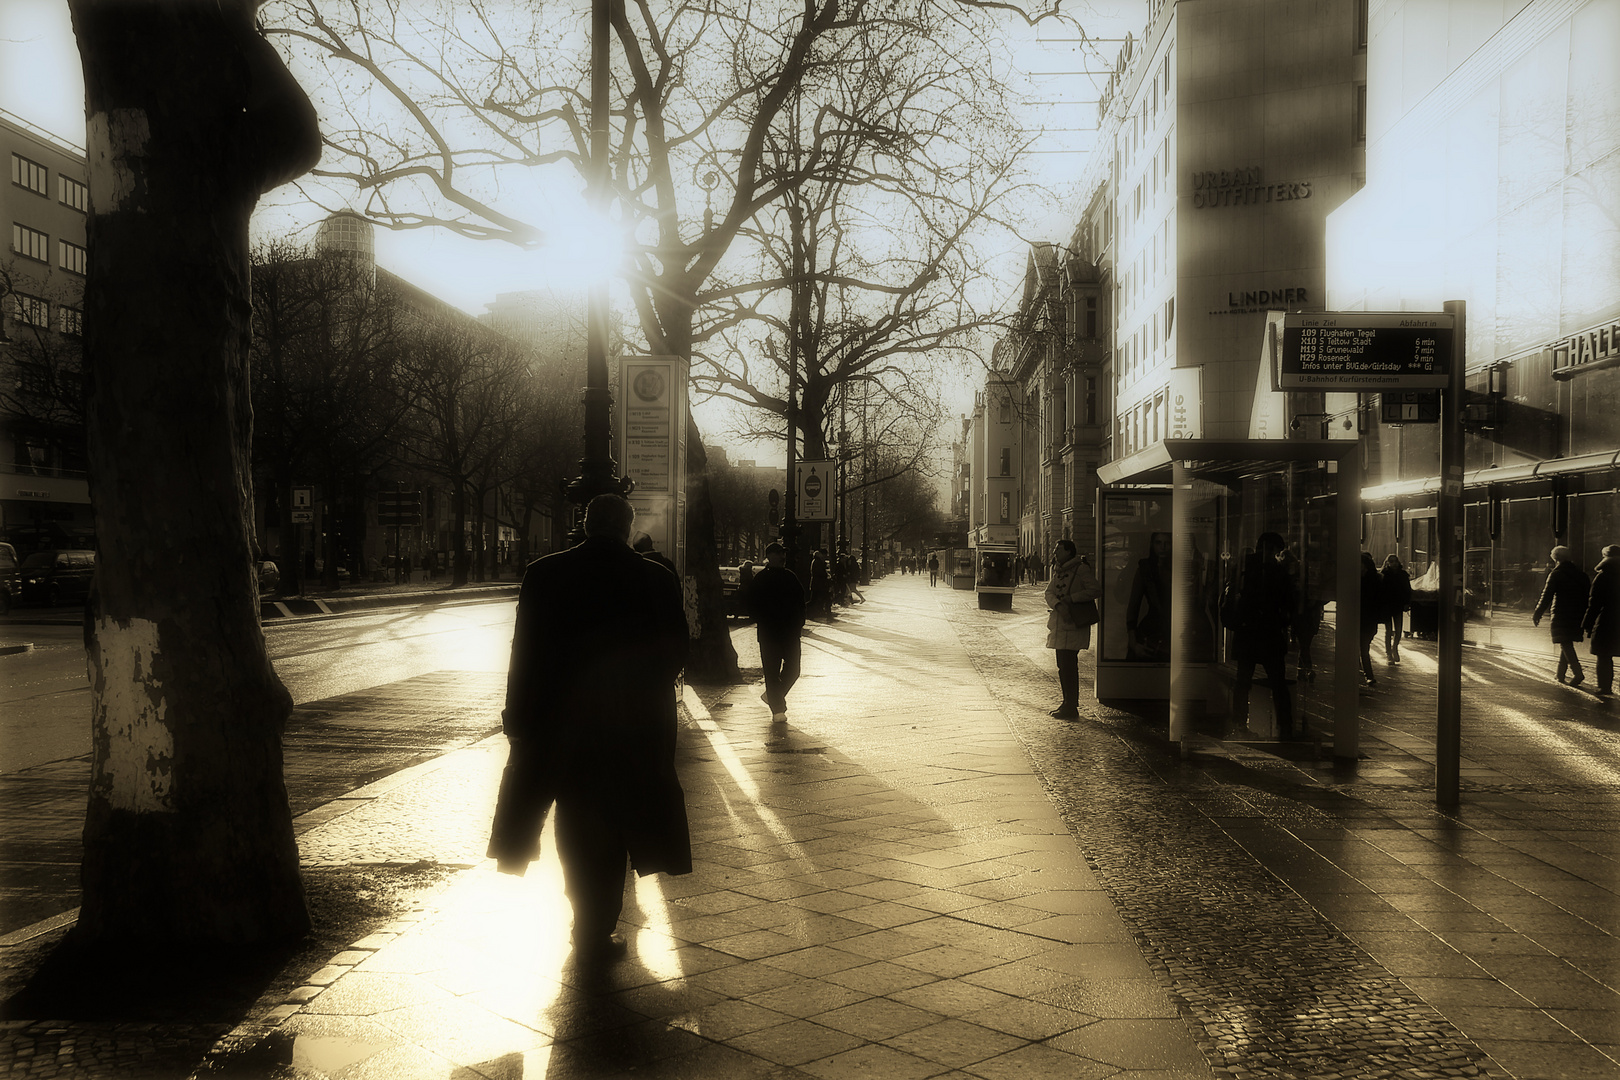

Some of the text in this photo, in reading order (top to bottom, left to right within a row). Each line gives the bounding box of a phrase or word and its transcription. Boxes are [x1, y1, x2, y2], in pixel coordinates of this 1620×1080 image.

[1193, 166, 1261, 190] URBAN
[1193, 181, 1311, 208] OUTFITTERS
[1229, 287, 1307, 306] LINDNER
[1301, 329, 1376, 338] 109 Flughafen Tegel
[1301, 337, 1317, 345] X10
[1352, 337, 1372, 345] Stadt
[1415, 338, 1436, 346] 6 min
[1300, 345, 1316, 353] M19
[1415, 346, 1435, 354] 7 min
[1300, 353, 1351, 362] M29 Roseneck
[1414, 354, 1434, 362] 9 min
[1302, 362, 1320, 370] Infos
[1339, 375, 1399, 383] Kurfürstendamm
